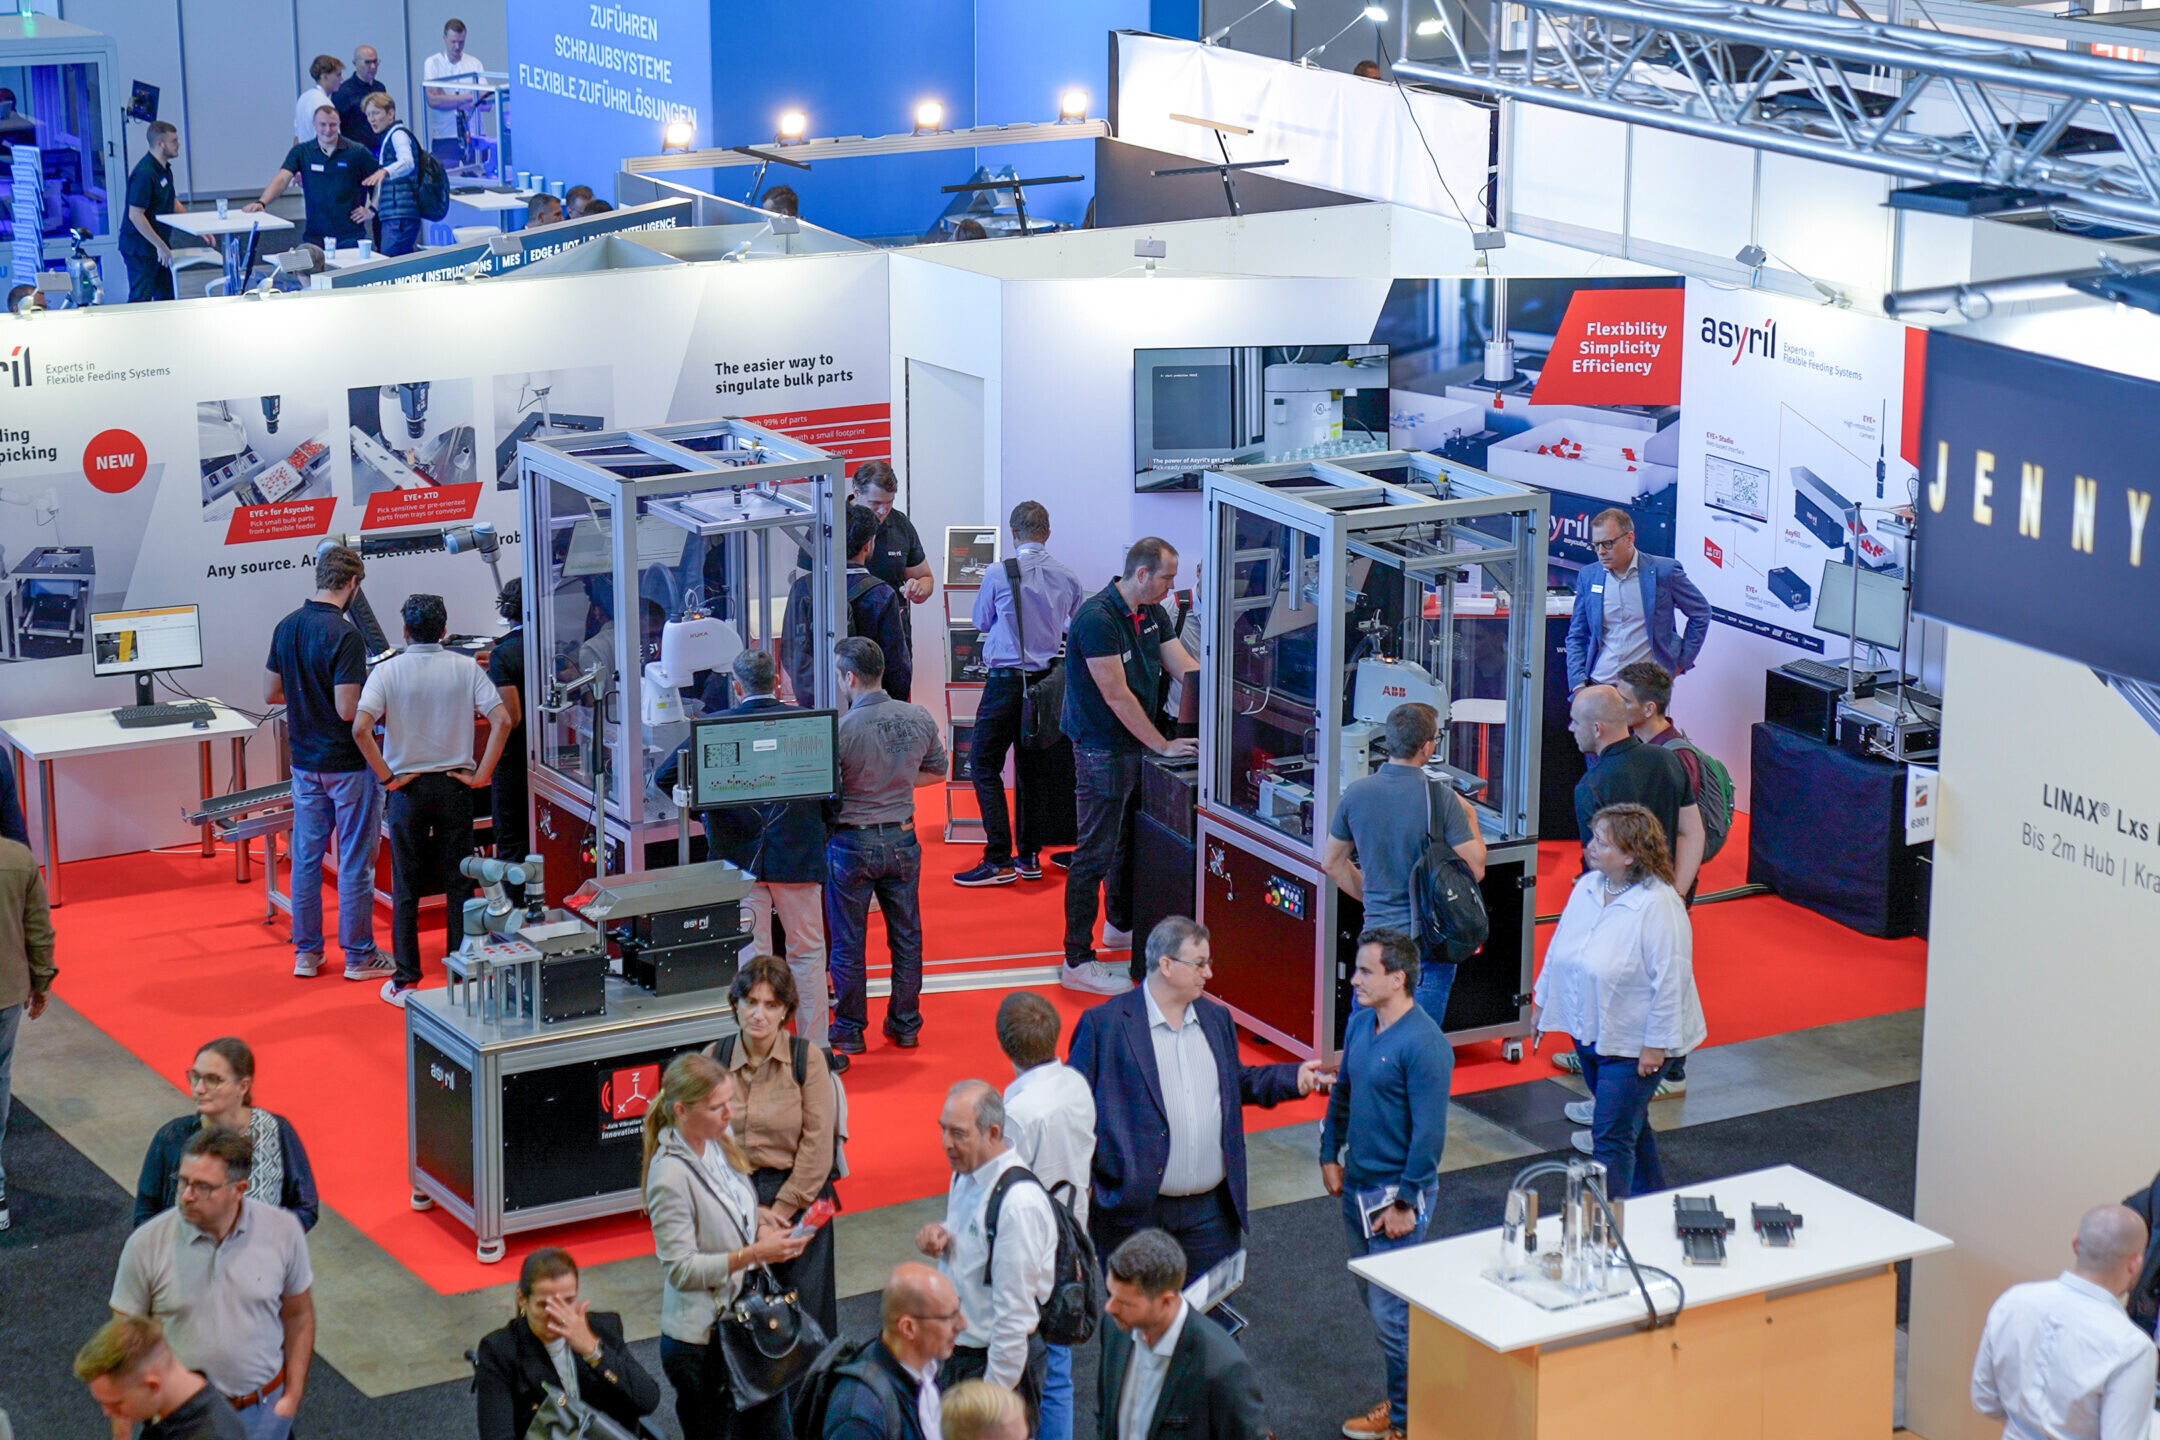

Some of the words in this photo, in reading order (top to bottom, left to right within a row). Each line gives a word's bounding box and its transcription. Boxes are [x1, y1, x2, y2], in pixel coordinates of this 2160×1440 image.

[590, 4, 658, 41] ZUFÜHREN
[555, 34, 672, 84] SCHRAUBSYSTEME
[519, 63, 576, 99] FLEXIBLE
[579, 79, 697, 130] ZUFÜHRLÖSUNGEN
[426, 259, 492, 282] INSTRUCONS
[502, 254, 521, 268] MES
[530, 245, 552, 262] EDGE
[1586, 322, 1667, 339] Flexibility
[1579, 341, 1660, 357] Simplicity
[1701, 317, 1776, 366] asyril
[1783, 342, 1807, 357] Experts
[1808, 348, 1815, 358] in
[45, 363, 83, 374] Experts
[86, 361, 95, 370] in
[715, 362, 739, 375] The
[743, 358, 785, 373] easier
[789, 356, 816, 370] way
[820, 354, 833, 365] to
[1572, 359, 1652, 376] Efficiency
[1783, 353, 1807, 368] Flexible
[1808, 360, 1834, 375] Feeding
[1835, 365, 1862, 381] Systems
[46, 372, 84, 385] Flexible
[88, 370, 126, 382] Feeding
[129, 367, 171, 379] Systems
[715, 378, 780, 396] singulate
[784, 372, 814, 387] bulk
[818, 370, 853, 387] parts
[764, 418, 778, 426] 99%
[780, 416, 788, 425] of
[789, 415, 807, 426] parts
[816, 431, 834, 439] small
[836, 428, 865, 438] footprint
[96, 453, 135, 470] NEW
[404, 493, 422, 501] EYE+
[424, 491, 439, 499] XTD
[1928, 440, 2151, 567] JENNY
[250, 510, 268, 518] EYE+
[283, 505, 314, 515] Asycube
[391, 504, 417, 512] sensitive
[427, 499, 466, 510] pre-oriented
[265, 518, 281, 526] small
[298, 515, 314, 523] parts
[377, 514, 393, 522] parts
[411, 511, 426, 519] trays
[435, 507, 466, 516] conveyors
[1549, 512, 1589, 542] yril
[207, 565, 235, 579] Any
[241, 559, 296, 574] source.
[1745, 585, 1757, 594] EYE+
[1382, 685, 1406, 697] ABB
[1911, 816, 1929, 829] 6301
[2117, 809, 2149, 841] Lxs
[2022, 822, 2045, 851] Bis
[2052, 833, 2076, 863] 2m
[2083, 843, 2115, 877] Hub
[632, 1072, 640, 1082] Z
[617, 1104, 625, 1114] X
[601, 1127, 639, 1140] Innovation
